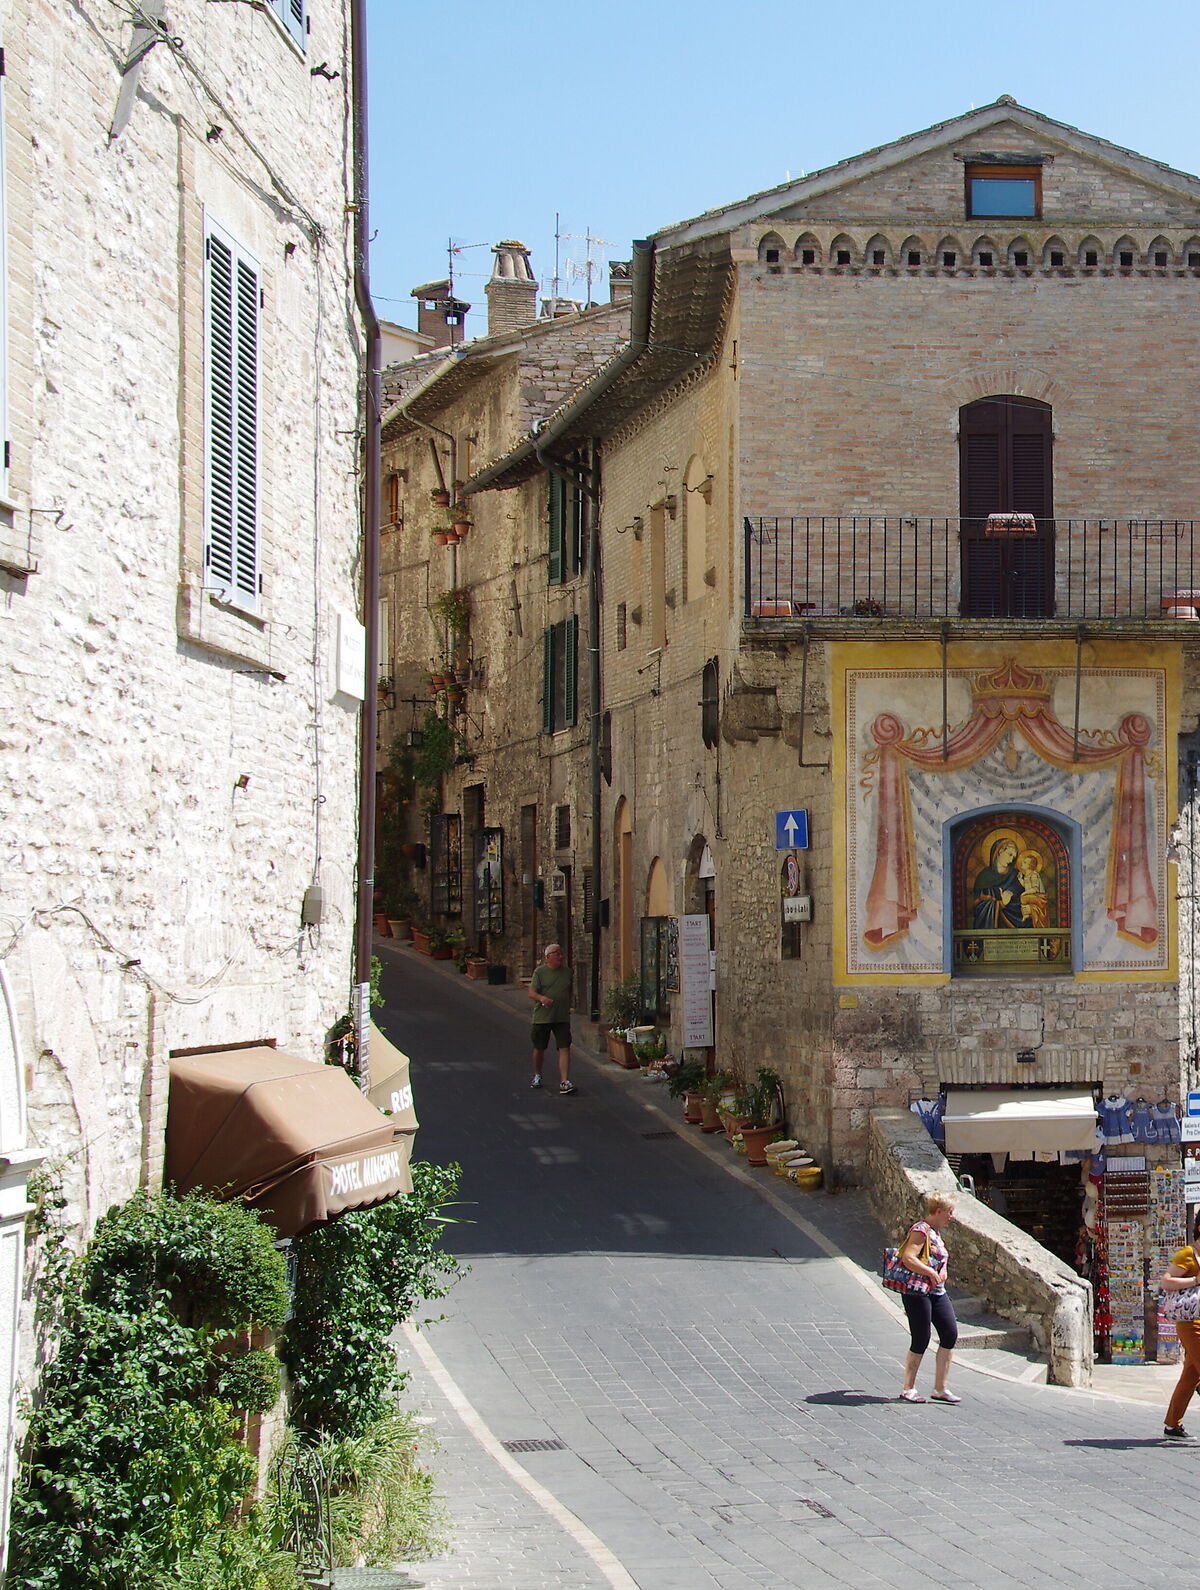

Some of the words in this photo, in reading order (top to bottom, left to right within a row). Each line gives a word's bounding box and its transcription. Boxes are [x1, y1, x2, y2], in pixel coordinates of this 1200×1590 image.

[1187, 1148, 1194, 1156] S.
[330, 1161, 361, 1196] HOTEL
[363, 1151, 400, 1186] MINERVA
